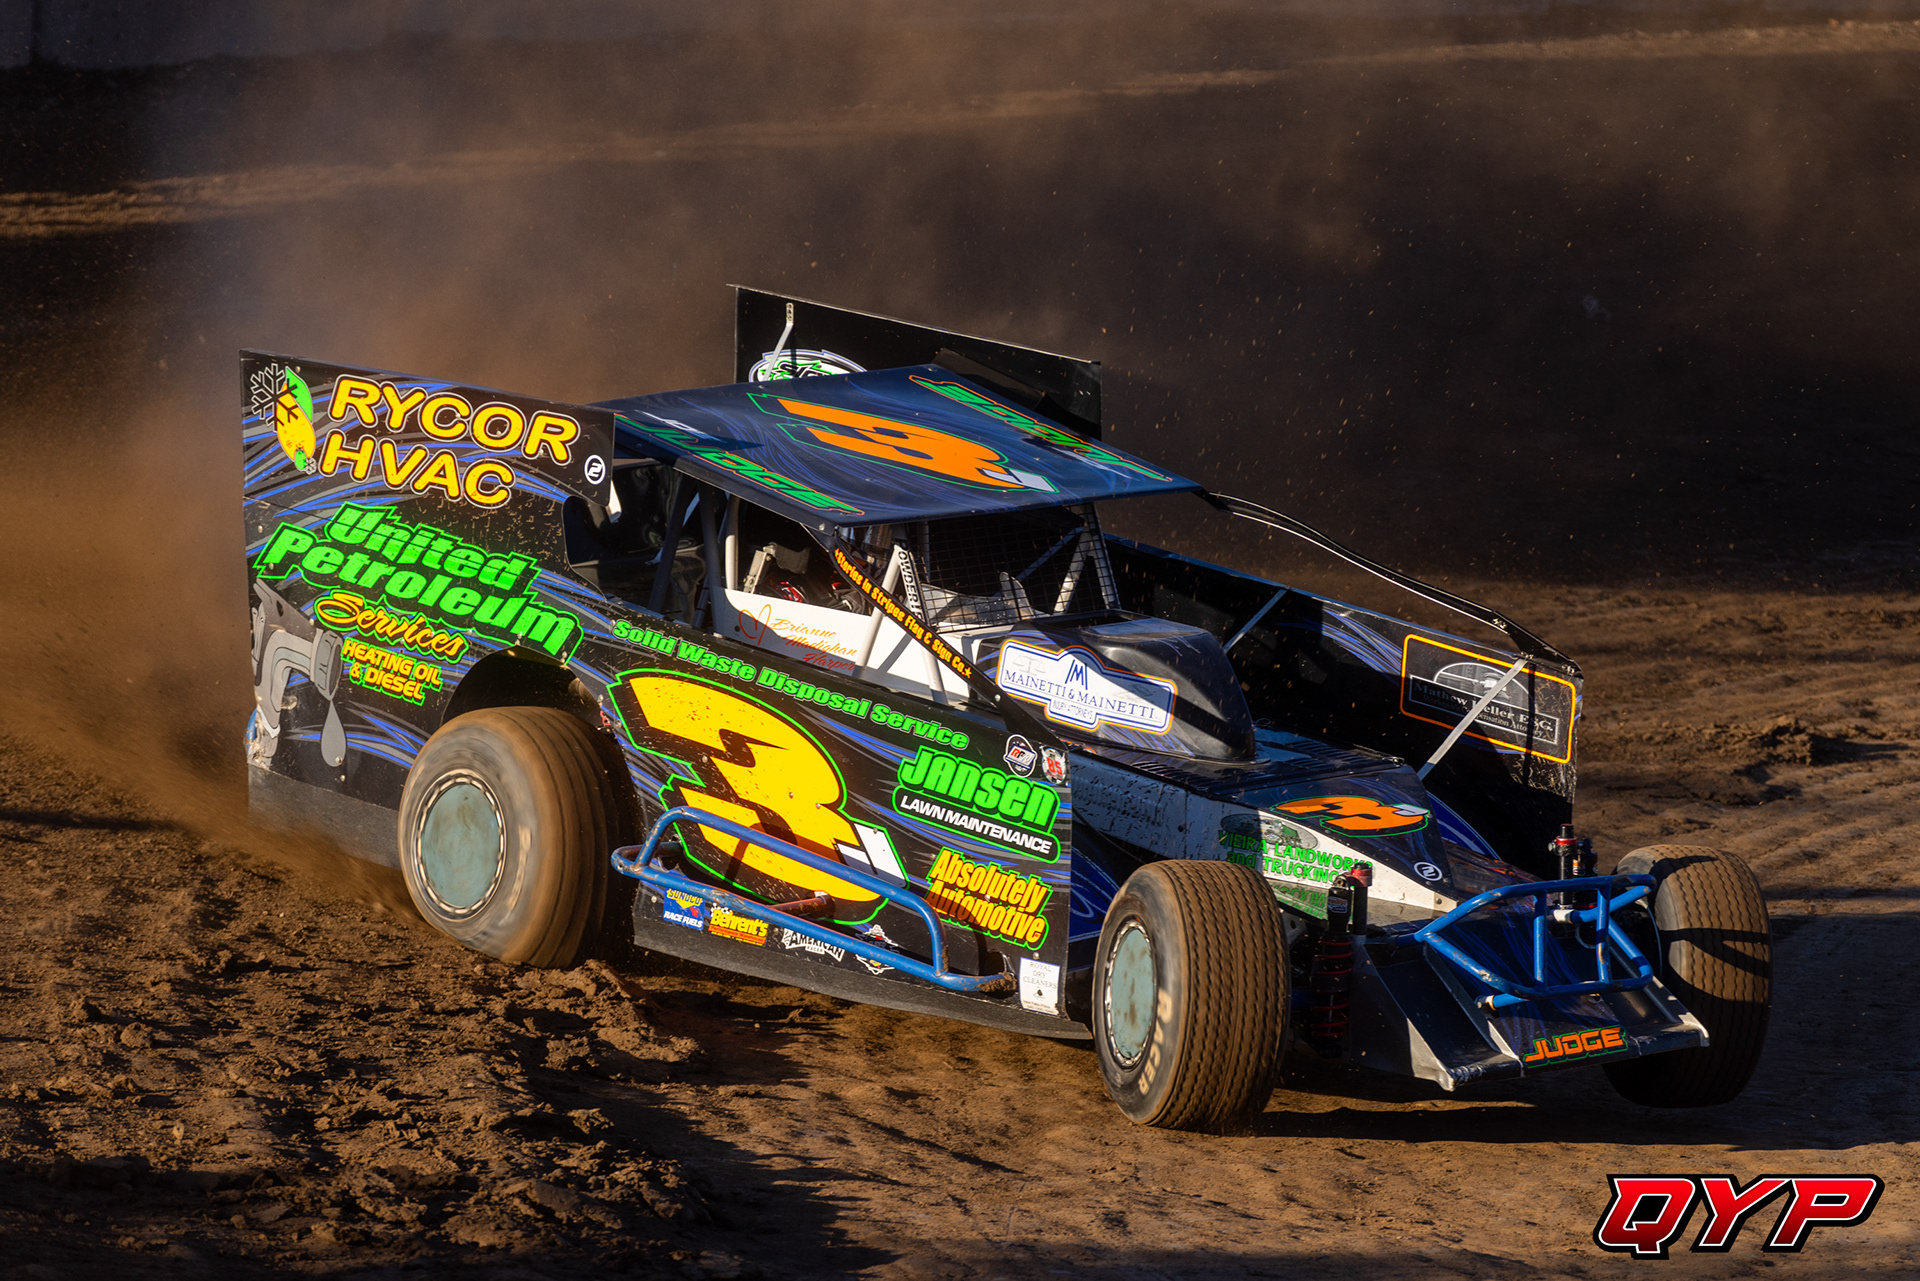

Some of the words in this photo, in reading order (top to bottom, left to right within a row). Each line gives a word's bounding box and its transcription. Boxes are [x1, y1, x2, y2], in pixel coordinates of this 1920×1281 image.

[328, 374, 581, 466] RYCOR
[318, 429, 517, 509] HVAC
[327, 507, 531, 592] United
[263, 527, 576, 656] Petroleum
[316, 592, 467, 657] Services
[769, 617, 837, 640] Brianne
[861, 578, 872, 594] in
[871, 586, 906, 622] Stripes
[903, 614, 925, 640] Flag
[931, 638, 953, 663] Sign
[342, 639, 414, 674] HEATING
[414, 663, 442, 687] OIL
[782, 634, 858, 657] Madighan
[802, 652, 856, 672] Harper
[350, 661, 361, 679] &
[364, 667, 425, 701] DIESEL
[612, 618, 675, 655] Solid
[677, 638, 756, 681] Waste
[757, 666, 870, 720] Disposal
[870, 703, 969, 750] Service
[1004, 669, 1066, 698] MAINETTI
[1067, 689, 1075, 699] &
[1077, 690, 1156, 719] MAINETTI
[900, 795, 946, 820] LAWN
[944, 809, 1053, 855] MAINTENANCE
[1217, 830, 1268, 855] VIEIRA
[1226, 850, 1257, 867] and
[667, 889, 702, 905] SUNOCO
[929, 849, 1048, 915] Absolutely
[664, 910, 683, 922] RACE
[682, 916, 703, 928] FUELS
[710, 908, 769, 937] Behrent's
[926, 879, 1046, 944] Automotive
[1022, 975, 1058, 989] CLEANERS
[1029, 961, 1052, 973] ROYAL
[1032, 970, 1046, 979] DRY
[1138, 987, 1174, 1096] RACER
[1524, 1026, 1625, 1063] JUDGE
